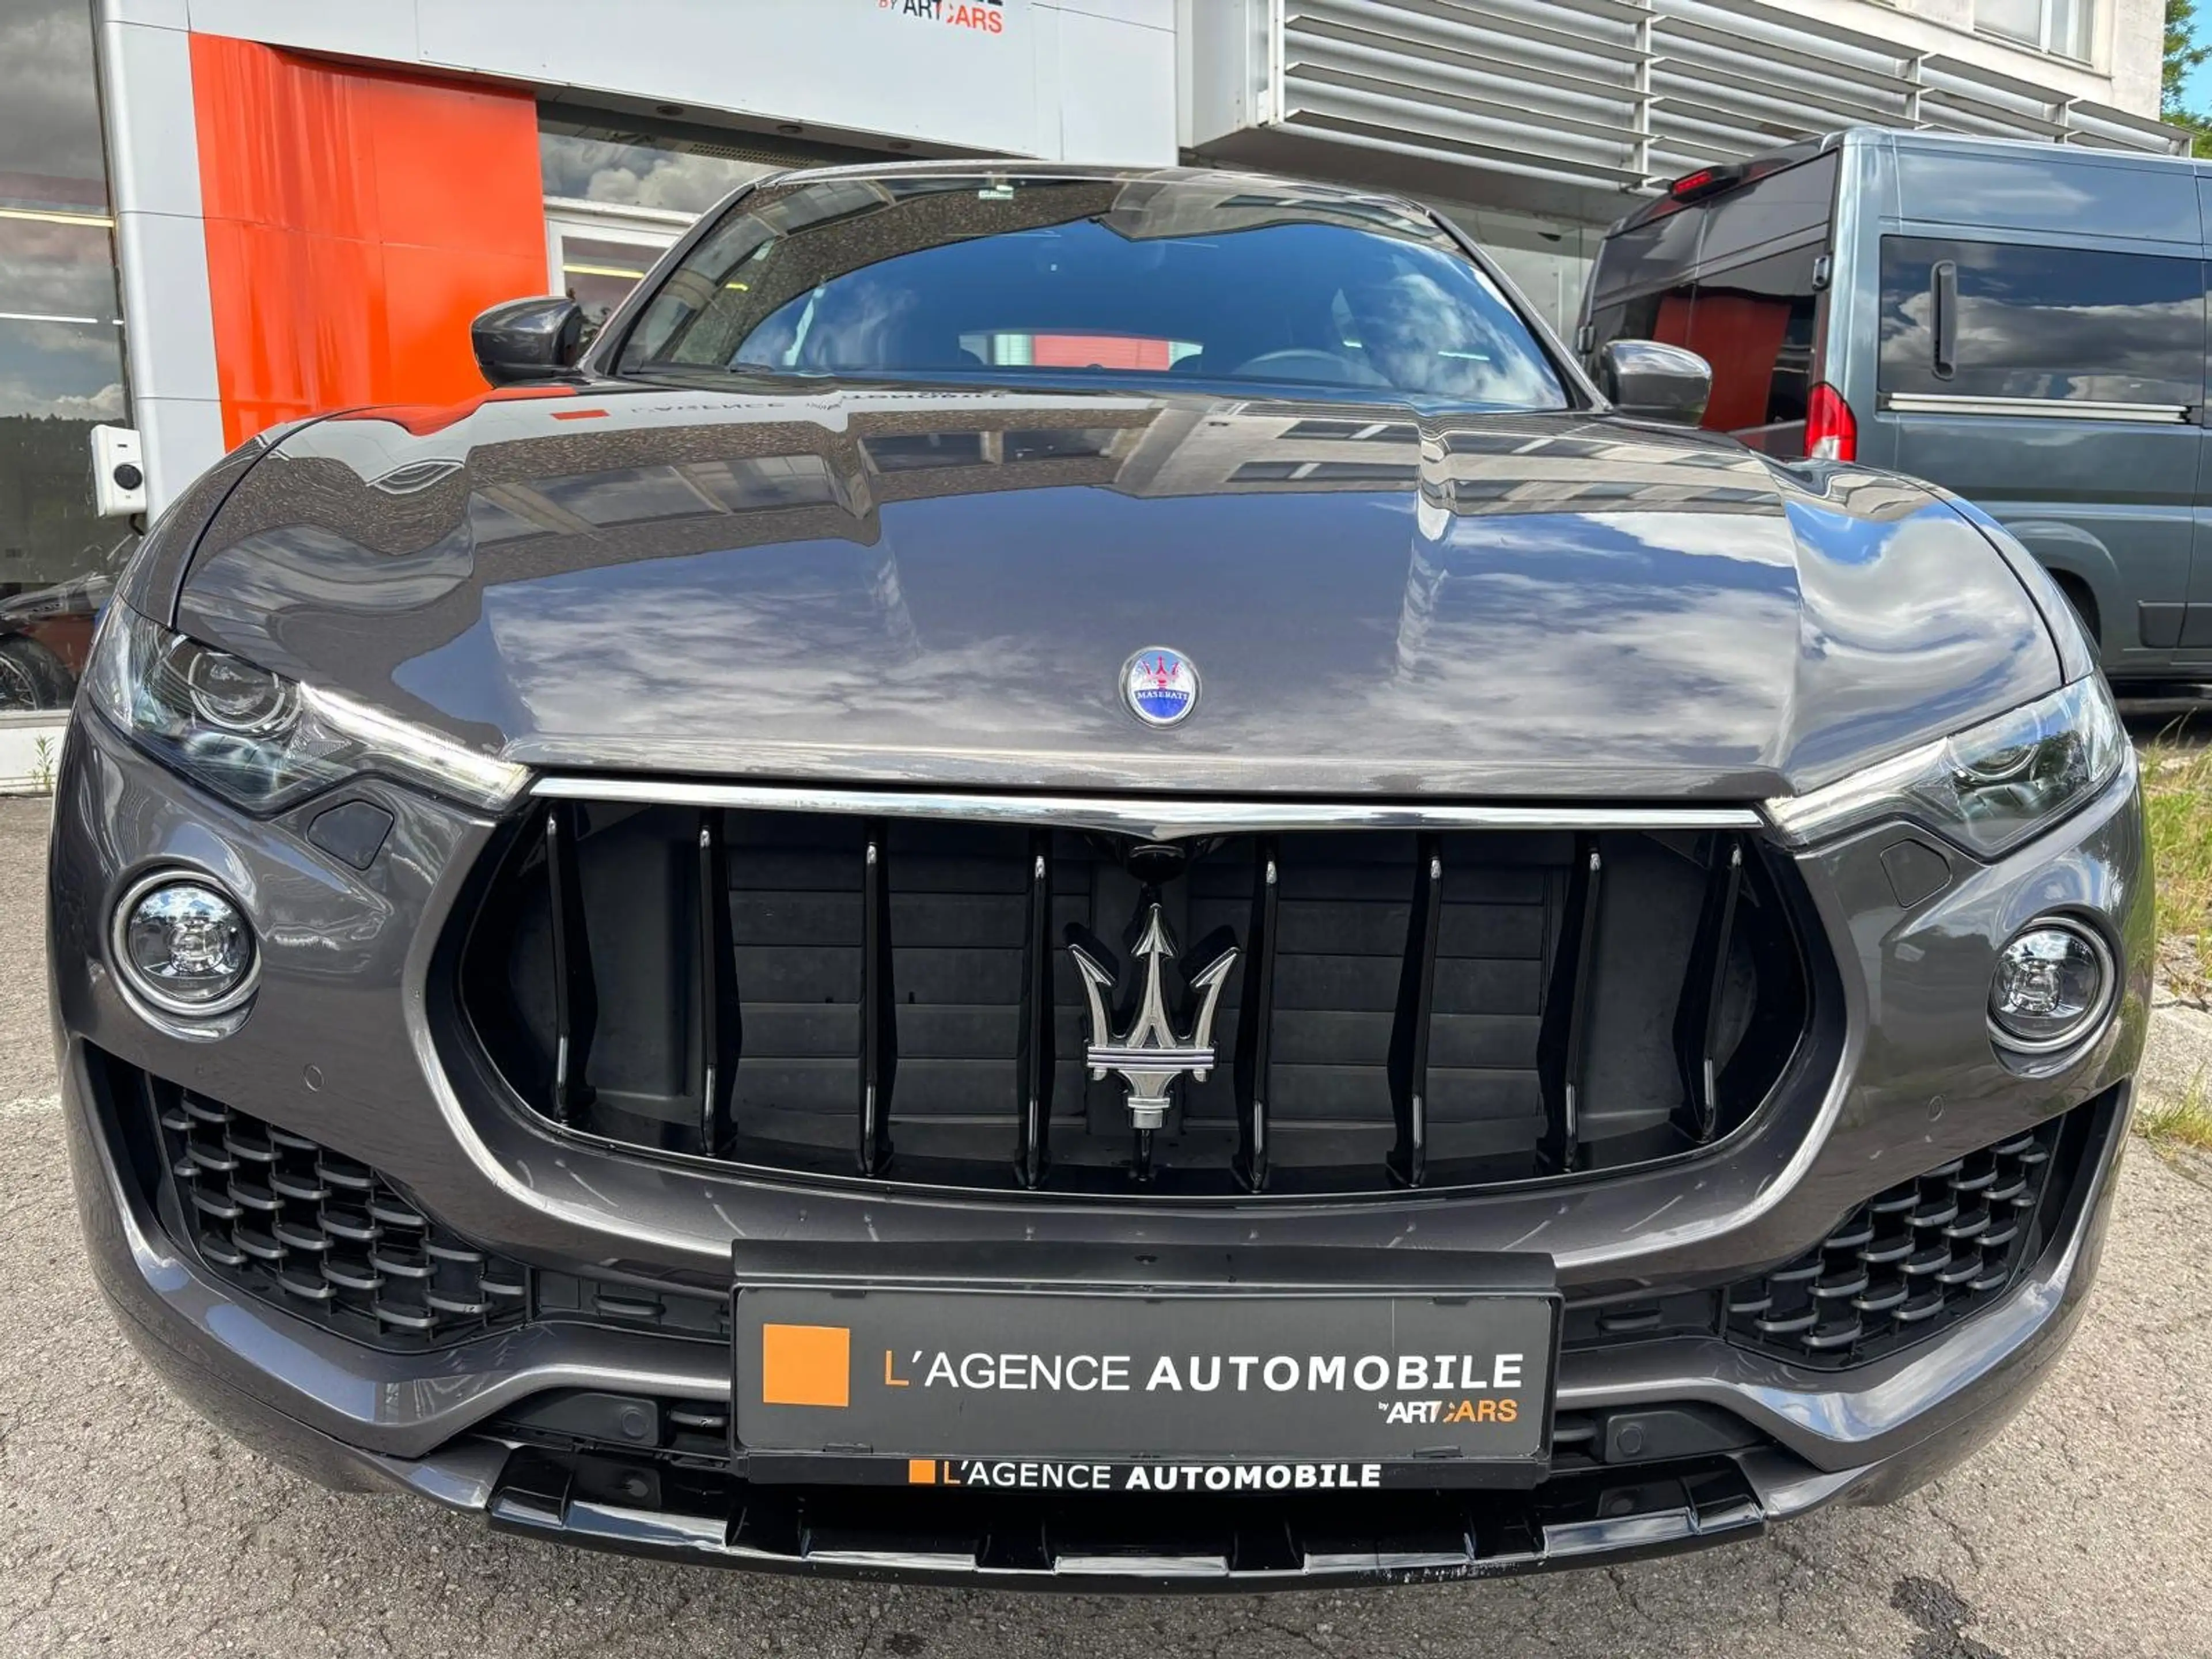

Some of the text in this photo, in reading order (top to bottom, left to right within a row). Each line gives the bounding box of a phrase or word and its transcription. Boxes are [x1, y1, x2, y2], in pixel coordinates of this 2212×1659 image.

[1137, 691, 1187, 700] MASERATI
[884, 1350, 1524, 1392] L'AGENCE AUTOMOBILE
[943, 1459, 1382, 1491] L'AGENCE AUTOMOBILE
